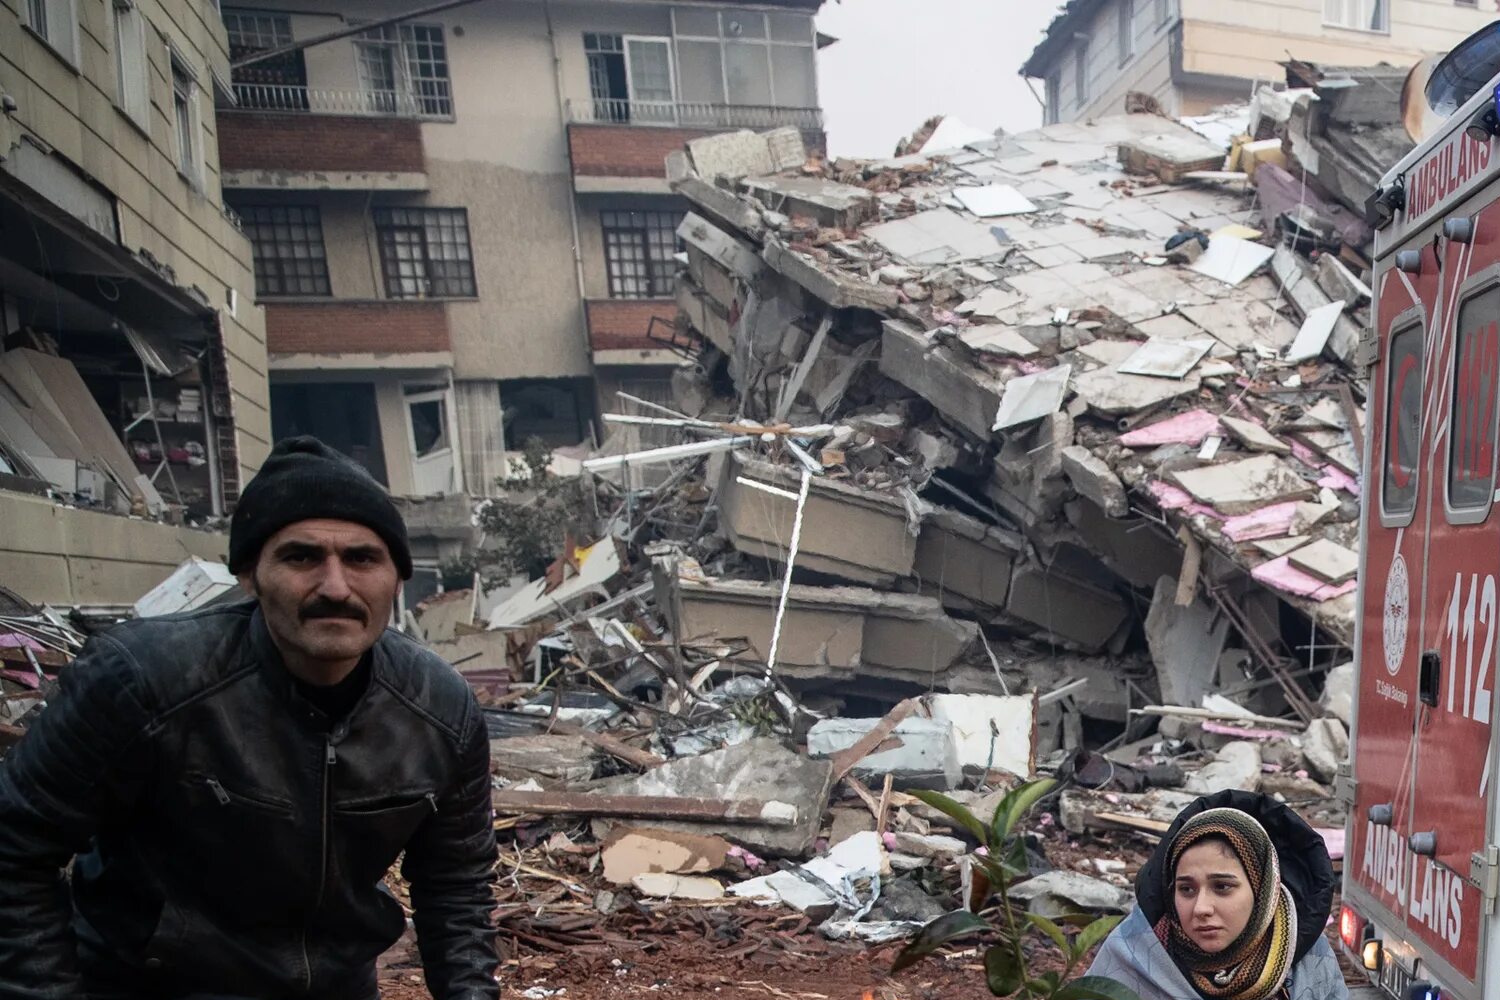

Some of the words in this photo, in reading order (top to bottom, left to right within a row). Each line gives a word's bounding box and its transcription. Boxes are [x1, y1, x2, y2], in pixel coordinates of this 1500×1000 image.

[1407, 131, 1492, 224] AMBULANS
[1457, 320, 1499, 481] 112
[1447, 572, 1496, 724] 112
